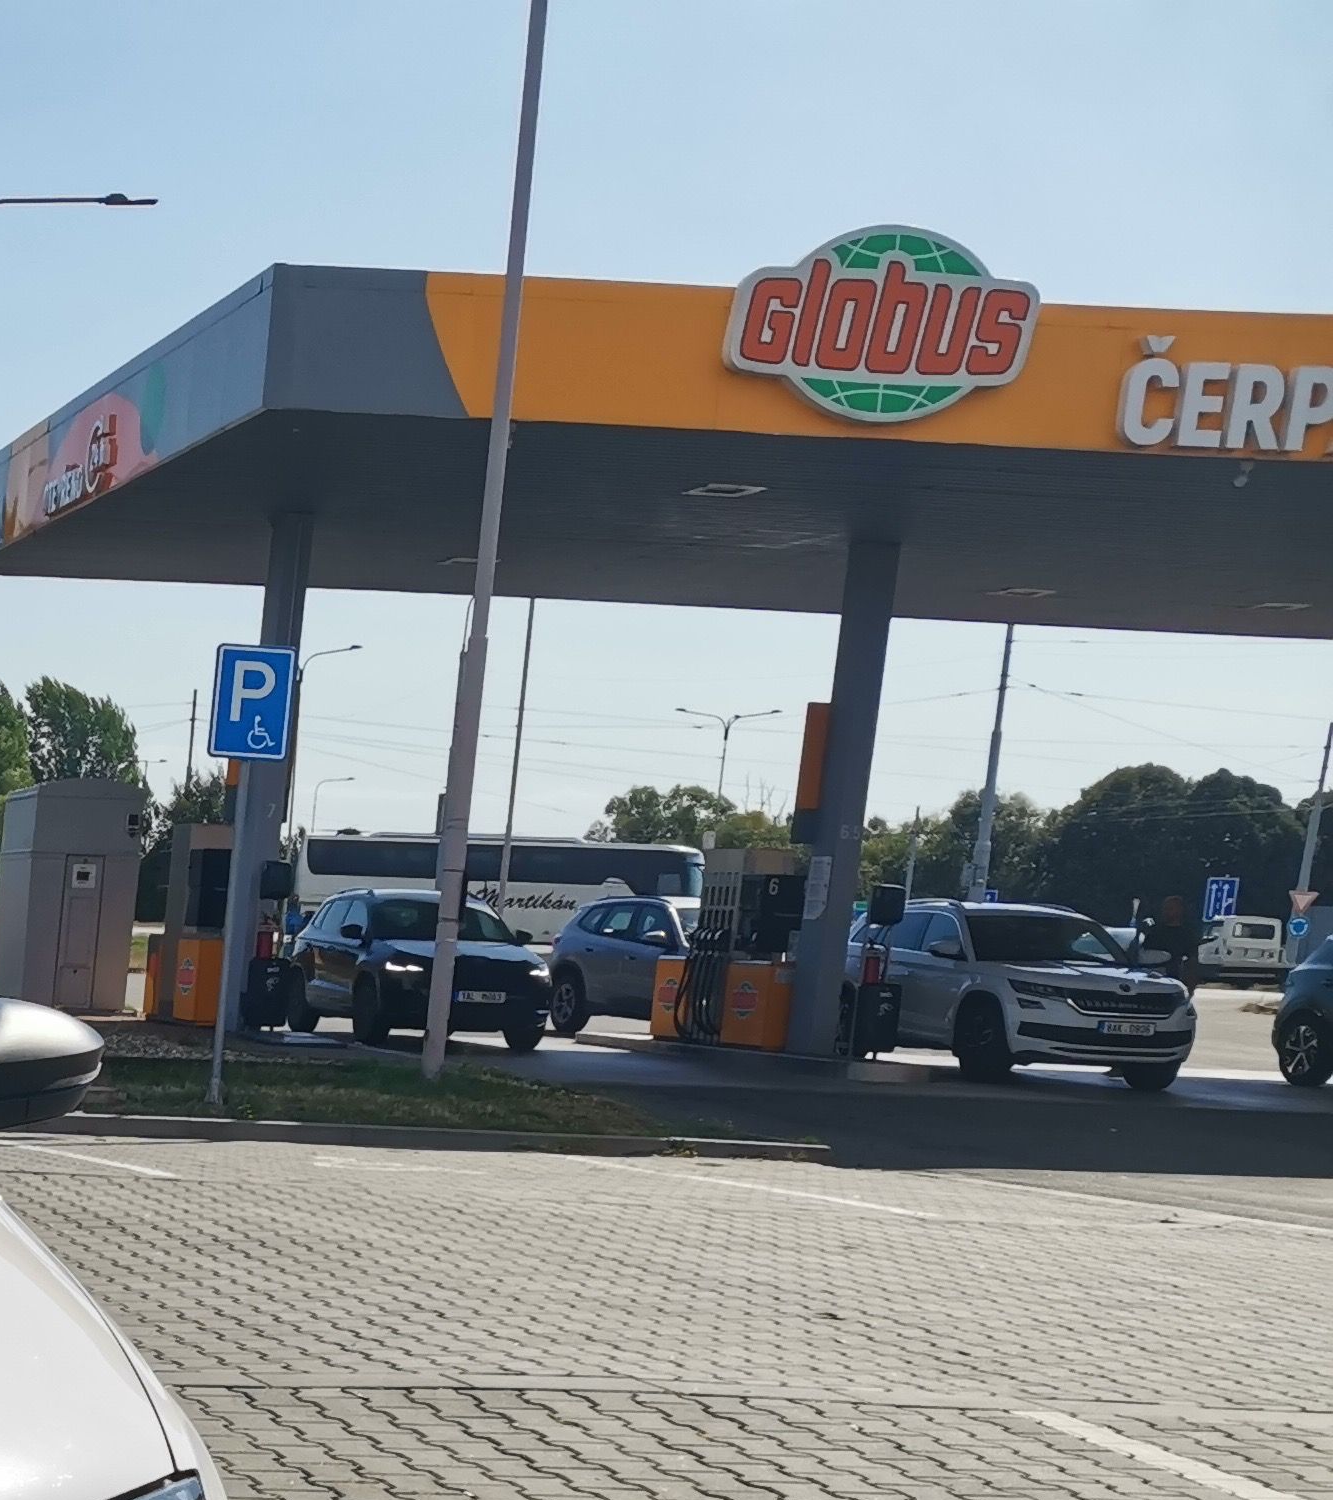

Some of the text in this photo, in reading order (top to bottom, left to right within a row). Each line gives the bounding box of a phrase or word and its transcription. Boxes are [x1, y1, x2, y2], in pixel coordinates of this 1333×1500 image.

[1119, 334, 1333, 451] ČERP
[229, 659, 276, 722] P
[769, 878, 780, 895] 6
